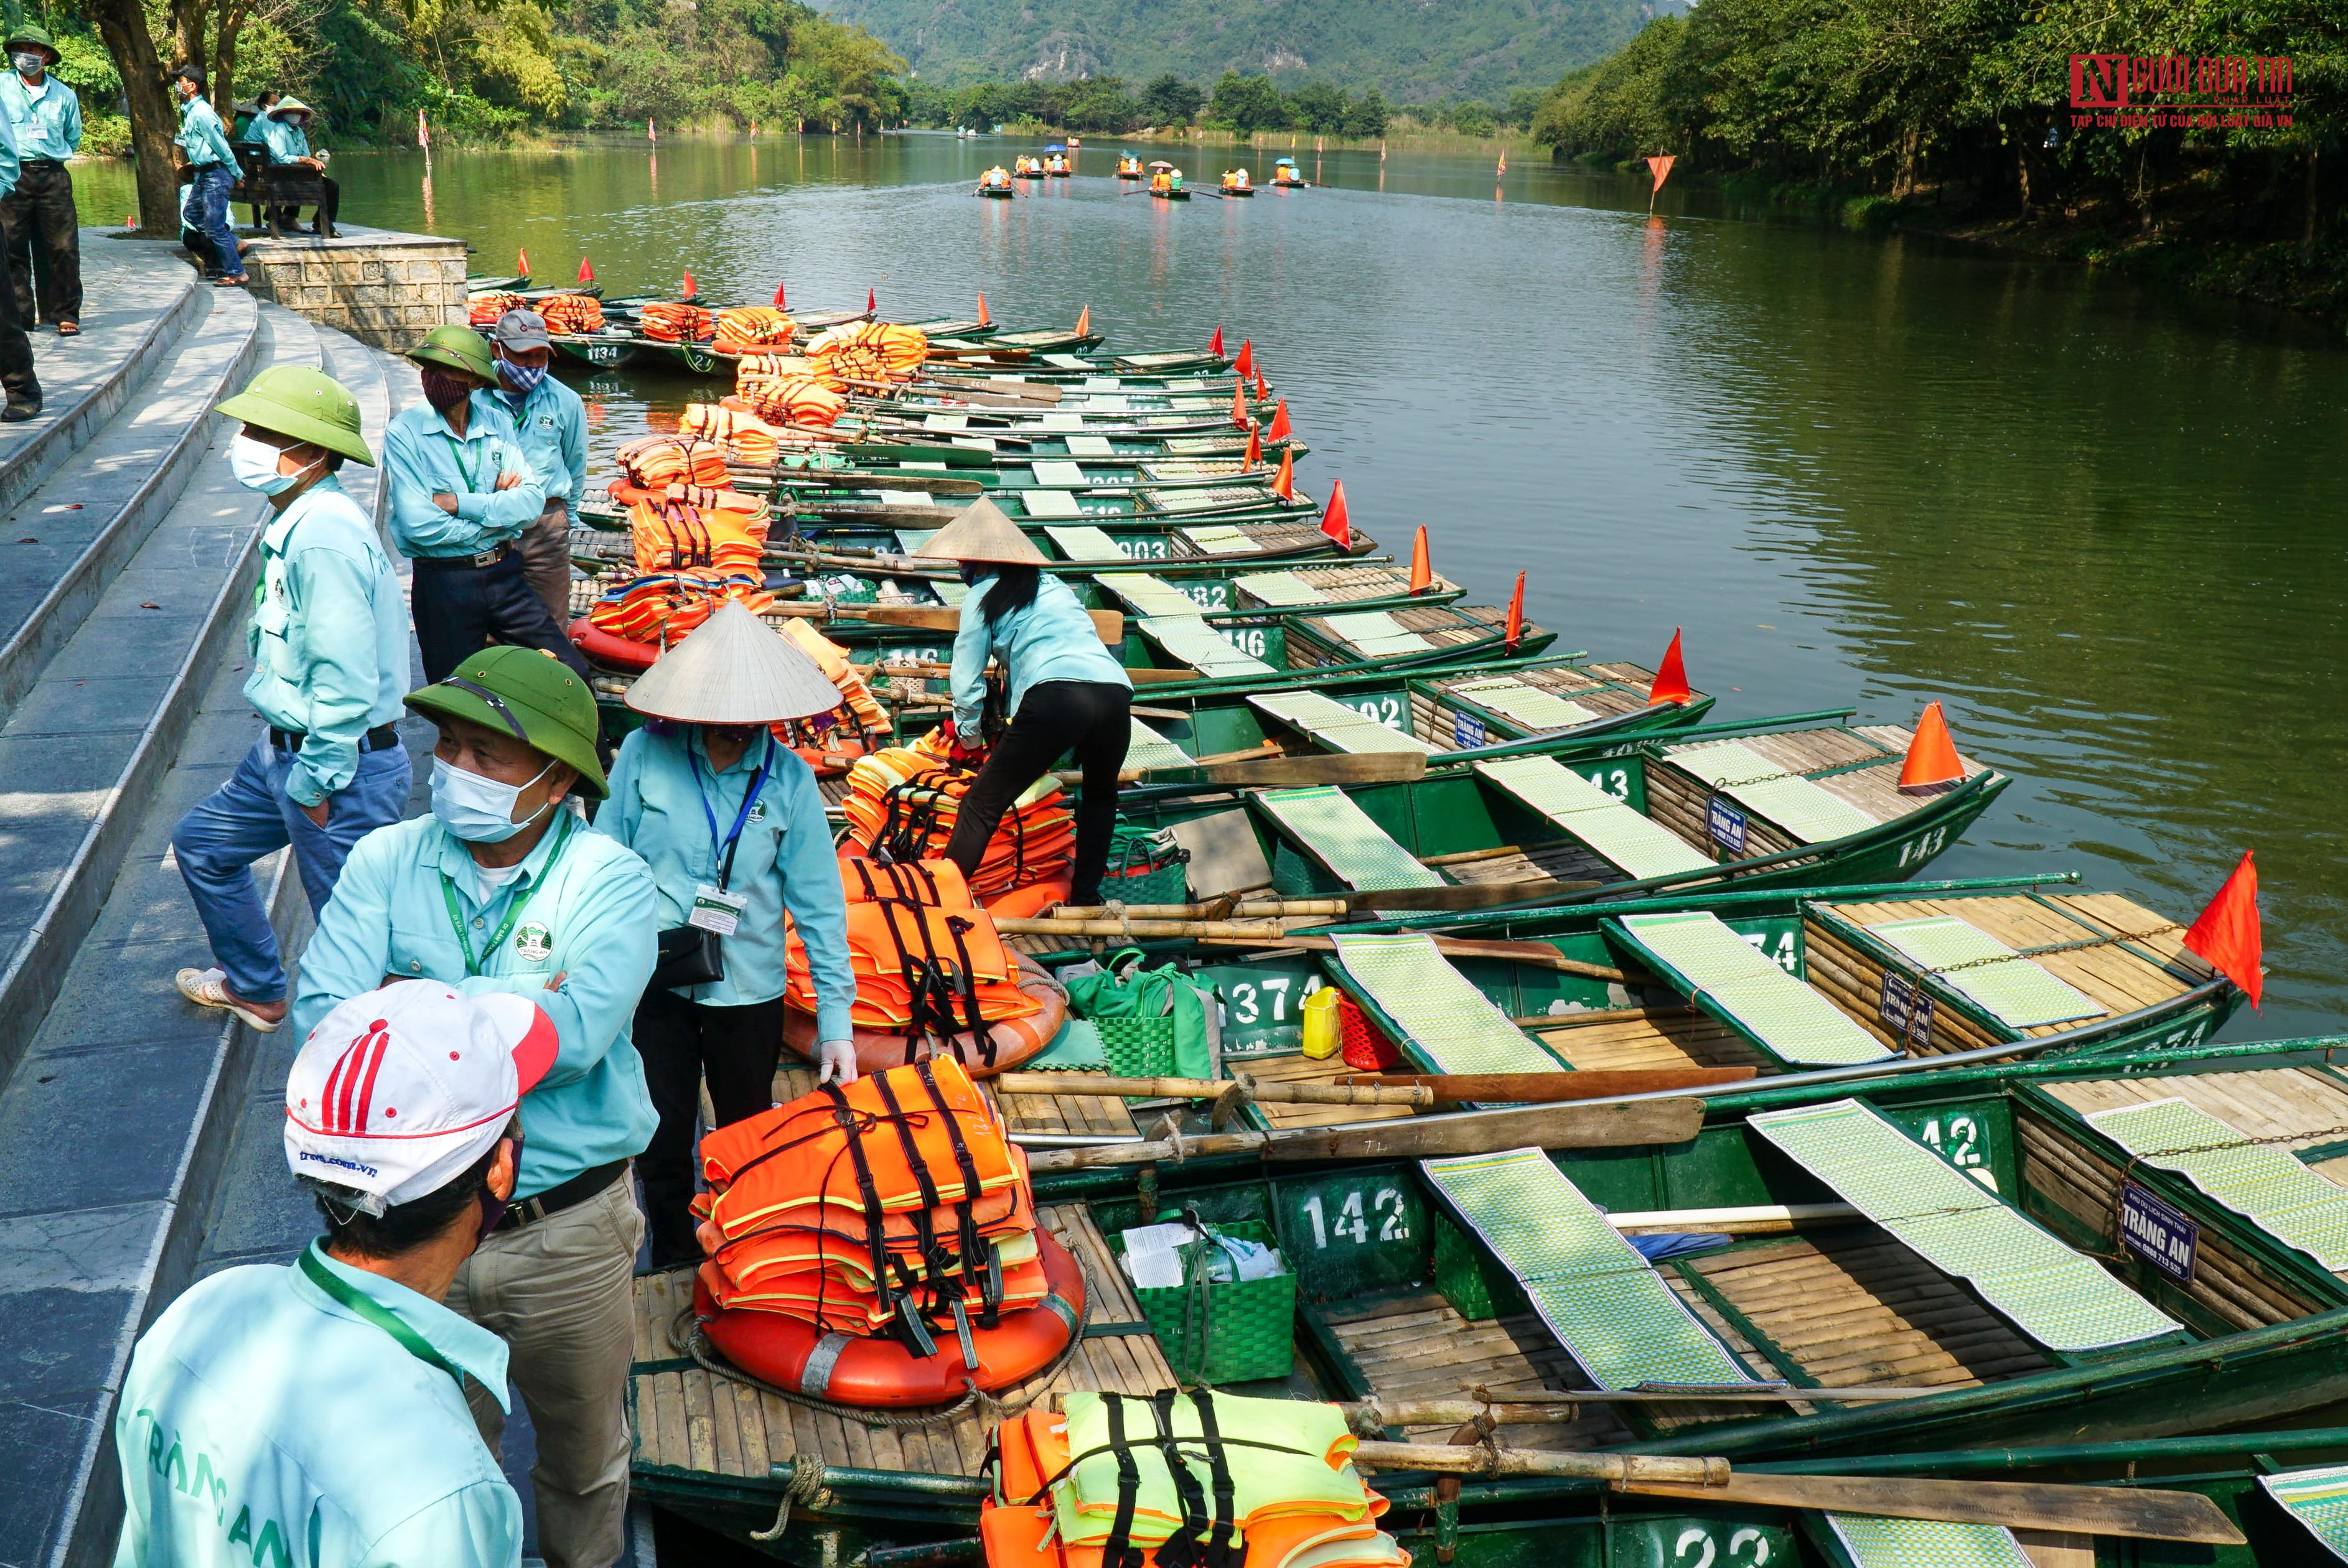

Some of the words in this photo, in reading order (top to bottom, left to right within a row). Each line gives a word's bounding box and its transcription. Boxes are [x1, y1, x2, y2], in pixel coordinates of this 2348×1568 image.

[587, 346, 618, 360] 1134
[1731, 822, 1742, 839] AN
[1915, 1010, 1929, 1027] AN
[1303, 1188, 1410, 1249] 142
[2130, 1193, 2140, 1203] KHU
[2141, 1200, 2148, 1209] DU
[2161, 1214, 2173, 1226] SINH
[2123, 1203, 2166, 1253] TRÀNG
[2168, 1236, 2189, 1267] AN
[2143, 1243, 2158, 1258] 0888
[2158, 1253, 2170, 1267] 713
[2169, 1261, 2182, 1275] 535
